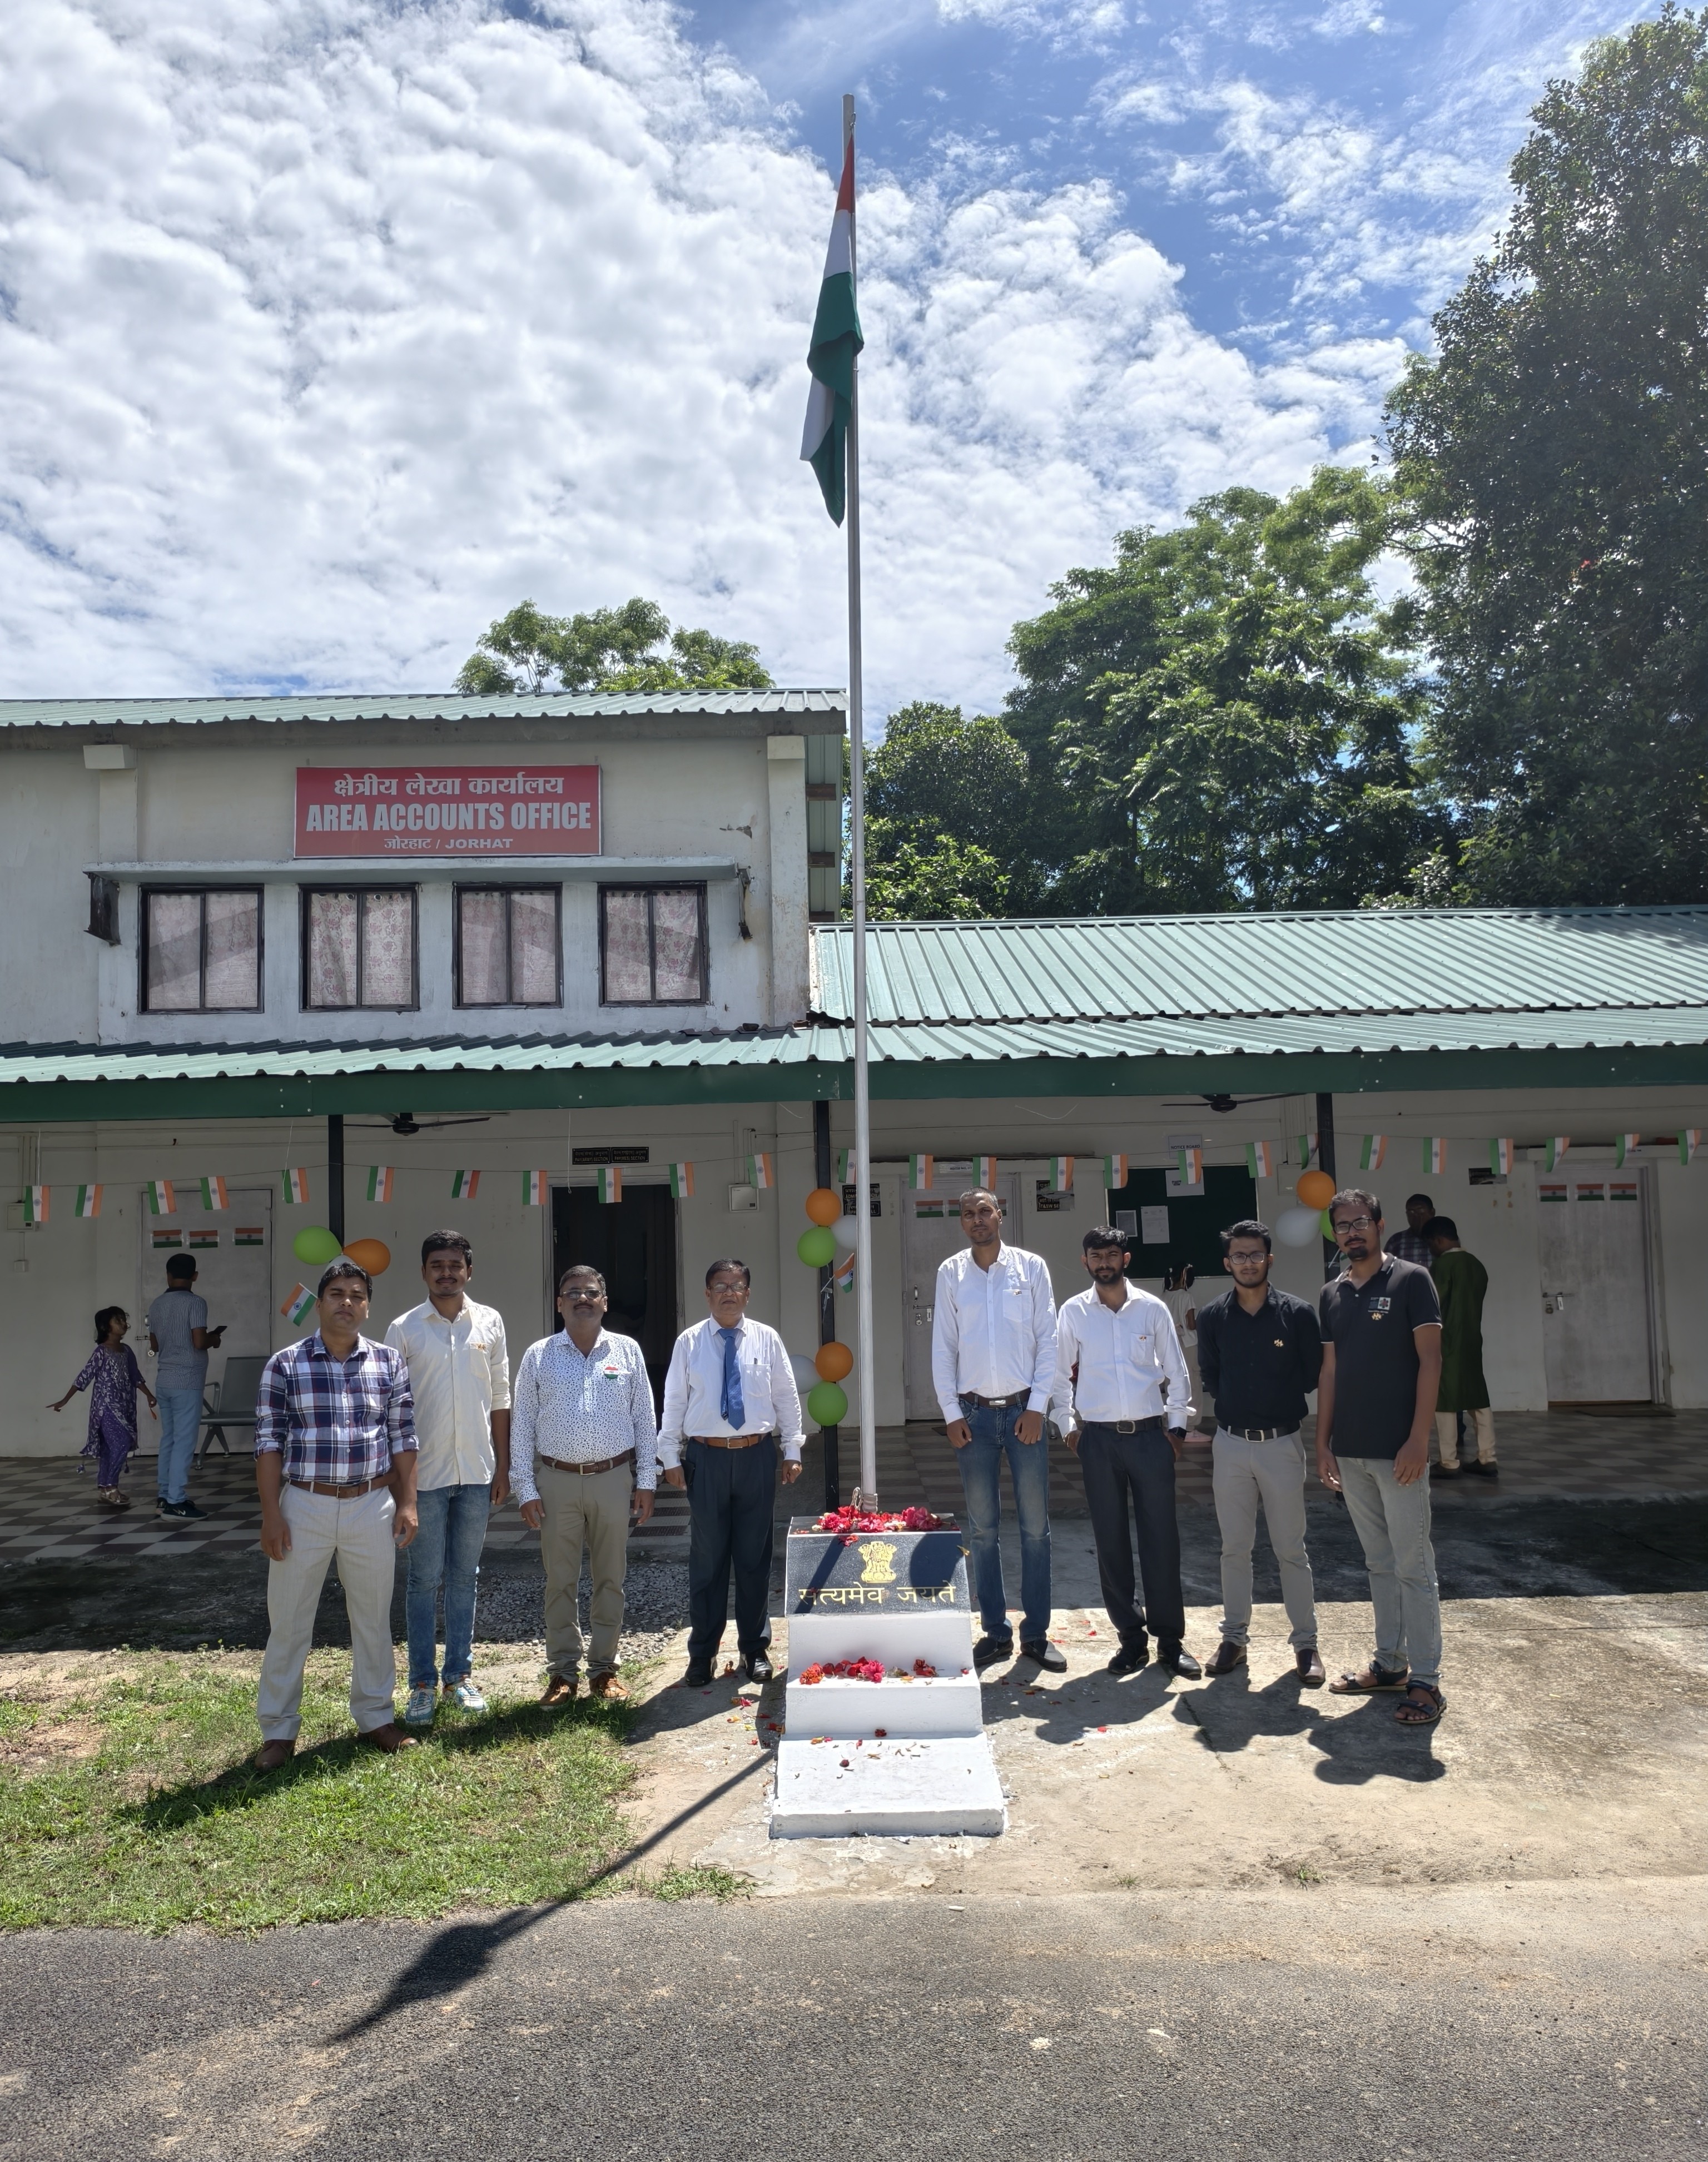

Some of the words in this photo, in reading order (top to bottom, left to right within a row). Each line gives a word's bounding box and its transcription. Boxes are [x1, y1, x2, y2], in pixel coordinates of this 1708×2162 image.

[335, 773, 399, 797] क्षेत्रीय
[405, 773, 461, 794] लेखा
[468, 772, 564, 794] कार्यालय
[306, 804, 369, 831] AREA
[373, 803, 504, 831] ACCOUNTS
[511, 802, 592, 829] OFFICE
[384, 835, 432, 849] जोरहाट
[445, 838, 513, 849] JORHAT
[798, 1582, 885, 1605] सत्यमेव
[896, 1580, 956, 1603] जयते
